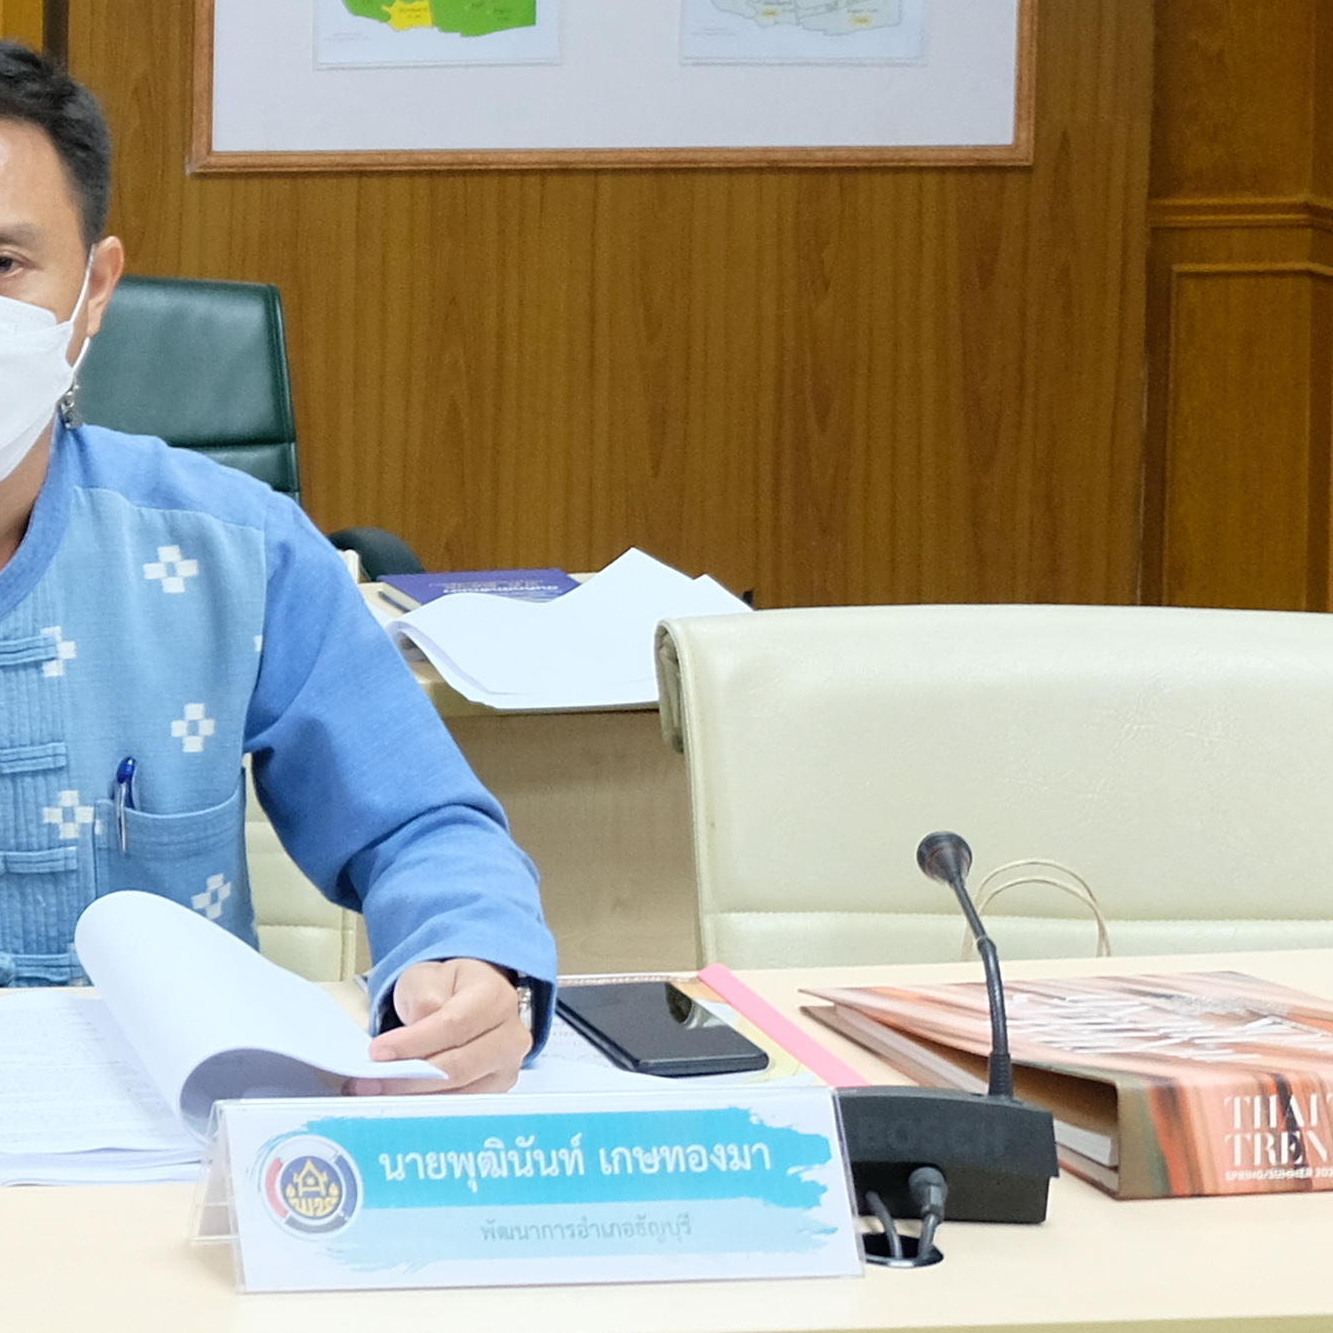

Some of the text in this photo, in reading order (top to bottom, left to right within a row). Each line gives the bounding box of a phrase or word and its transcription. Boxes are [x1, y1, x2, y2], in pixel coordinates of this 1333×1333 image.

[379, 1133, 772, 1193] นายพุฒินันท์ เกษทองมา
[480, 1213, 693, 1244] พัฒนาการอำเภอธัญบุรี
